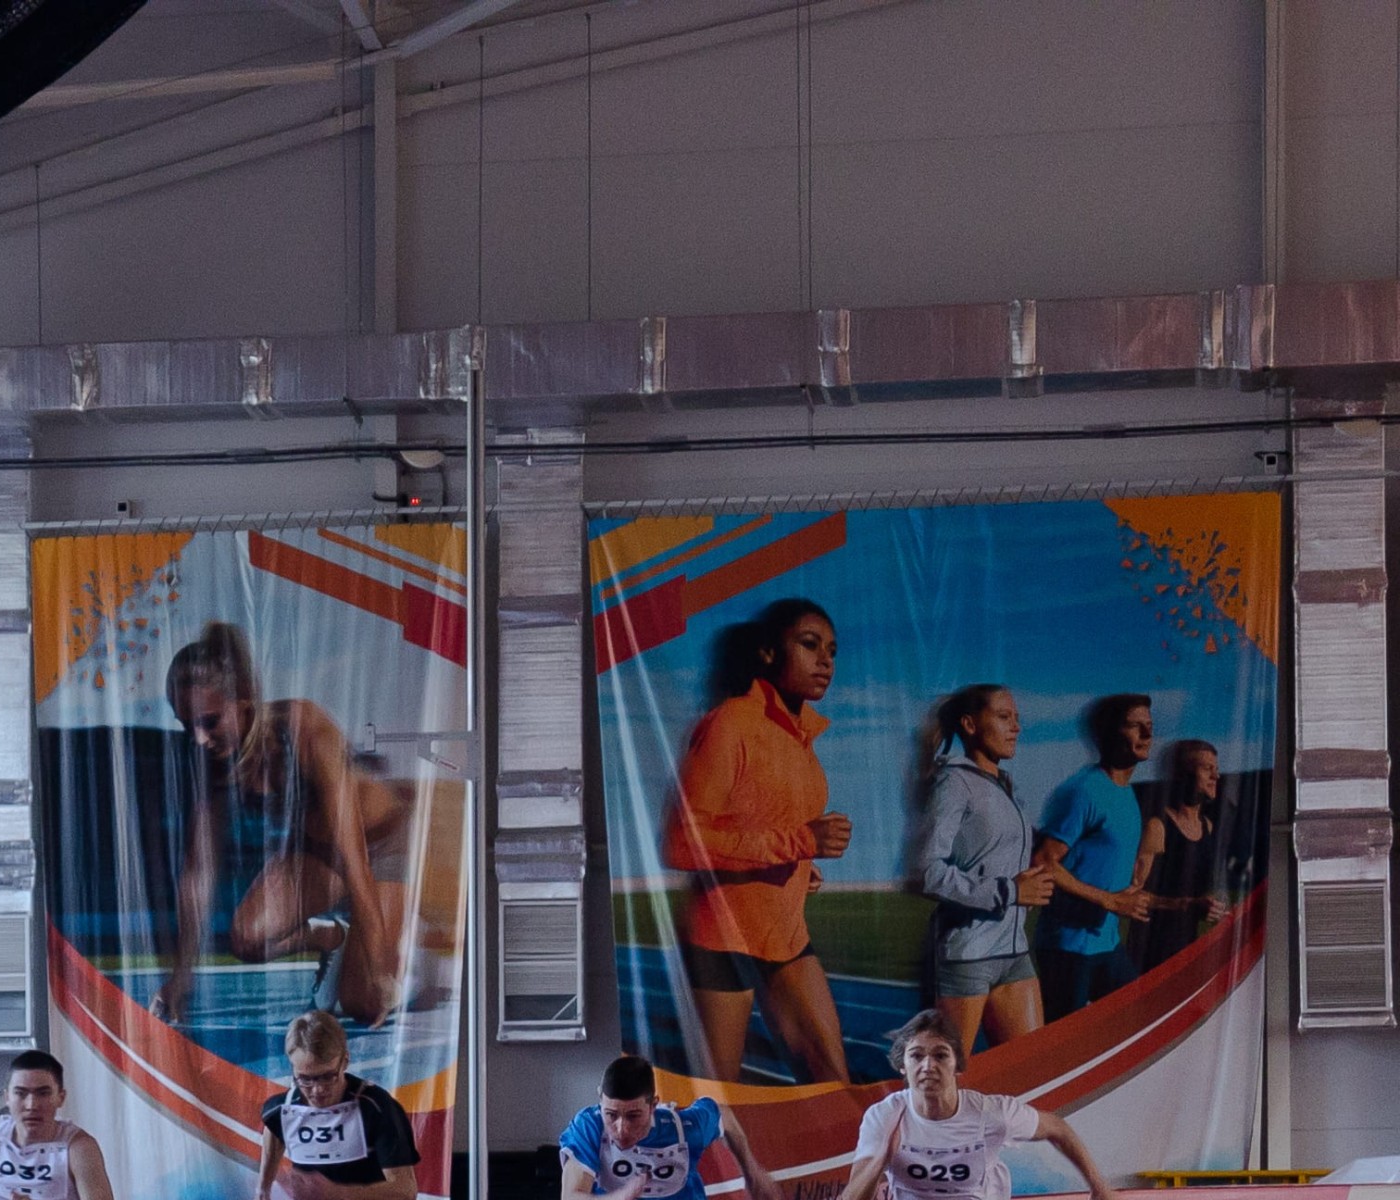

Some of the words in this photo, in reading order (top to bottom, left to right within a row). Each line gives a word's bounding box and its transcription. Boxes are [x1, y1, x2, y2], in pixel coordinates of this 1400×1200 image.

[298, 1124, 345, 1143] 031
[0, 1160, 52, 1181] 032
[907, 1163, 971, 1182] 029
